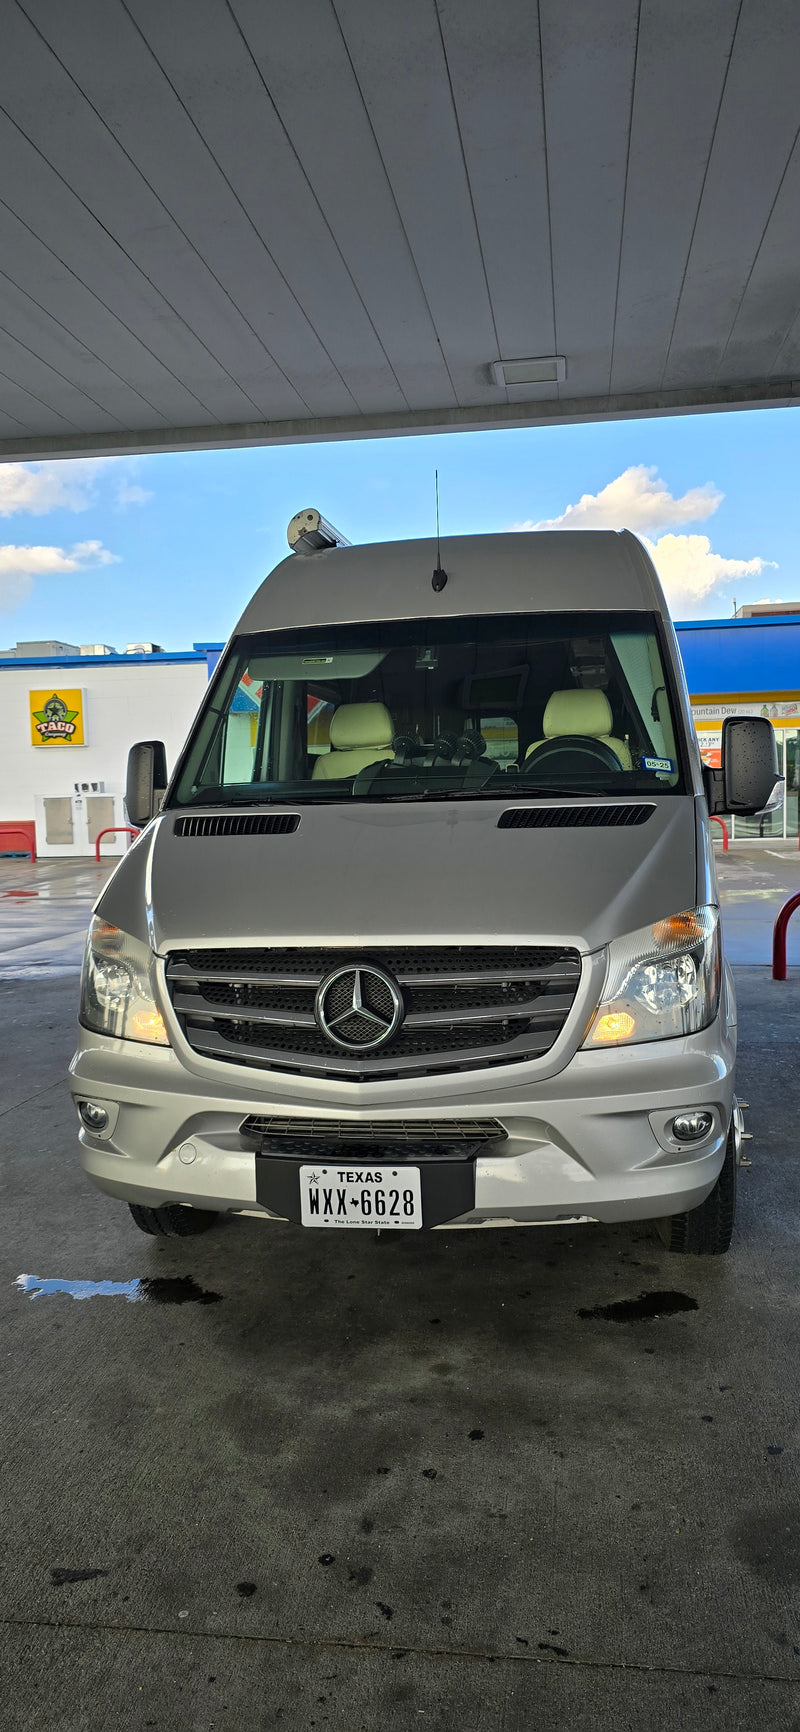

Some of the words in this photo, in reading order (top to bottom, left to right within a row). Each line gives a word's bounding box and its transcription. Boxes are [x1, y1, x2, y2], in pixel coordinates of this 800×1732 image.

[692, 707, 720, 716] ountain
[721, 706, 737, 715] Dew
[36, 721, 75, 734] TACO
[337, 1171, 383, 1183] TEXAS
[309, 1188, 347, 1215] WXX
[360, 1189, 415, 1216] 6628
